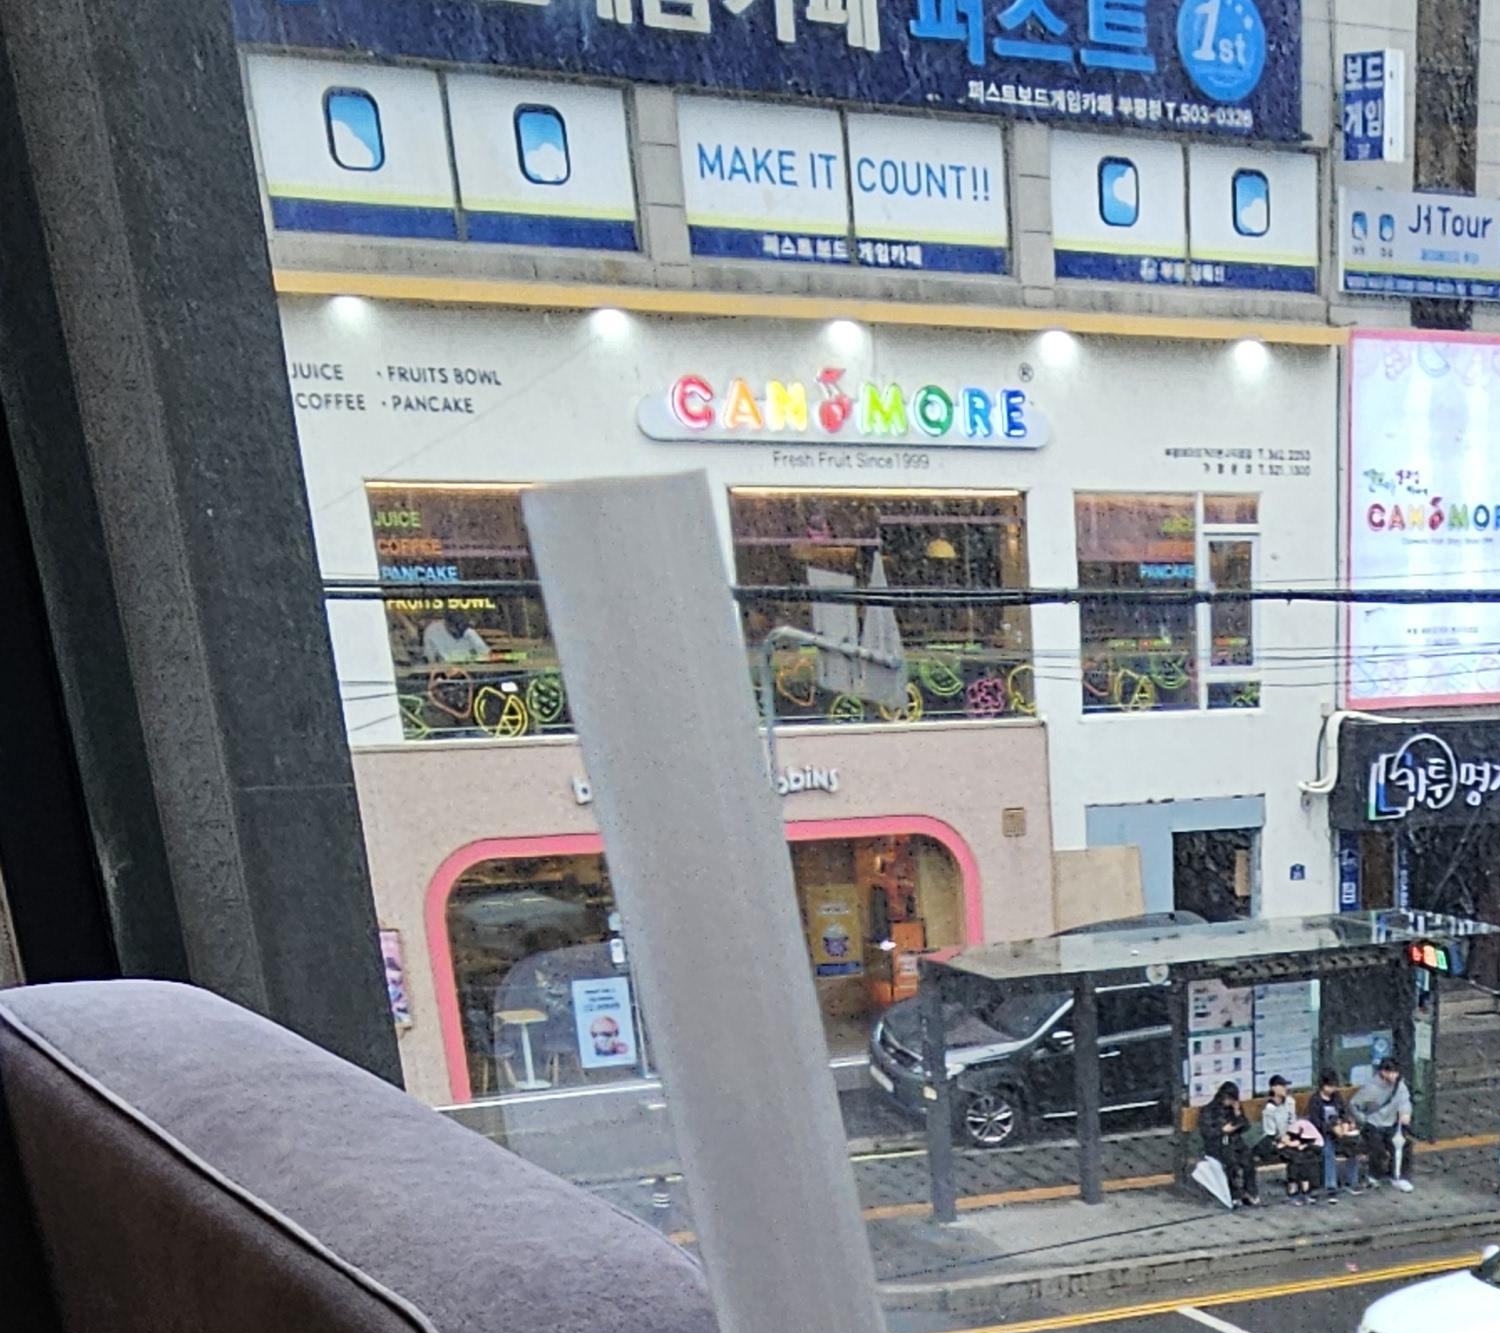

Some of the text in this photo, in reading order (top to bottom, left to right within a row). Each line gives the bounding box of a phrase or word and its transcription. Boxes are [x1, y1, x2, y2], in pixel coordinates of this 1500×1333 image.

[909, 0, 1156, 73] 퍼스트
[697, 143, 990, 201] MAKE IT COUNT!!
[292, 363, 502, 386] JUICE FRUITS BOWL
[295, 393, 475, 413] COFFEE PANCAKE
[772, 450, 815, 468] Fresh
[818, 451, 852, 469] Fruit
[373, 511, 421, 528] JUICE
[380, 565, 459, 581] PANCAKE
